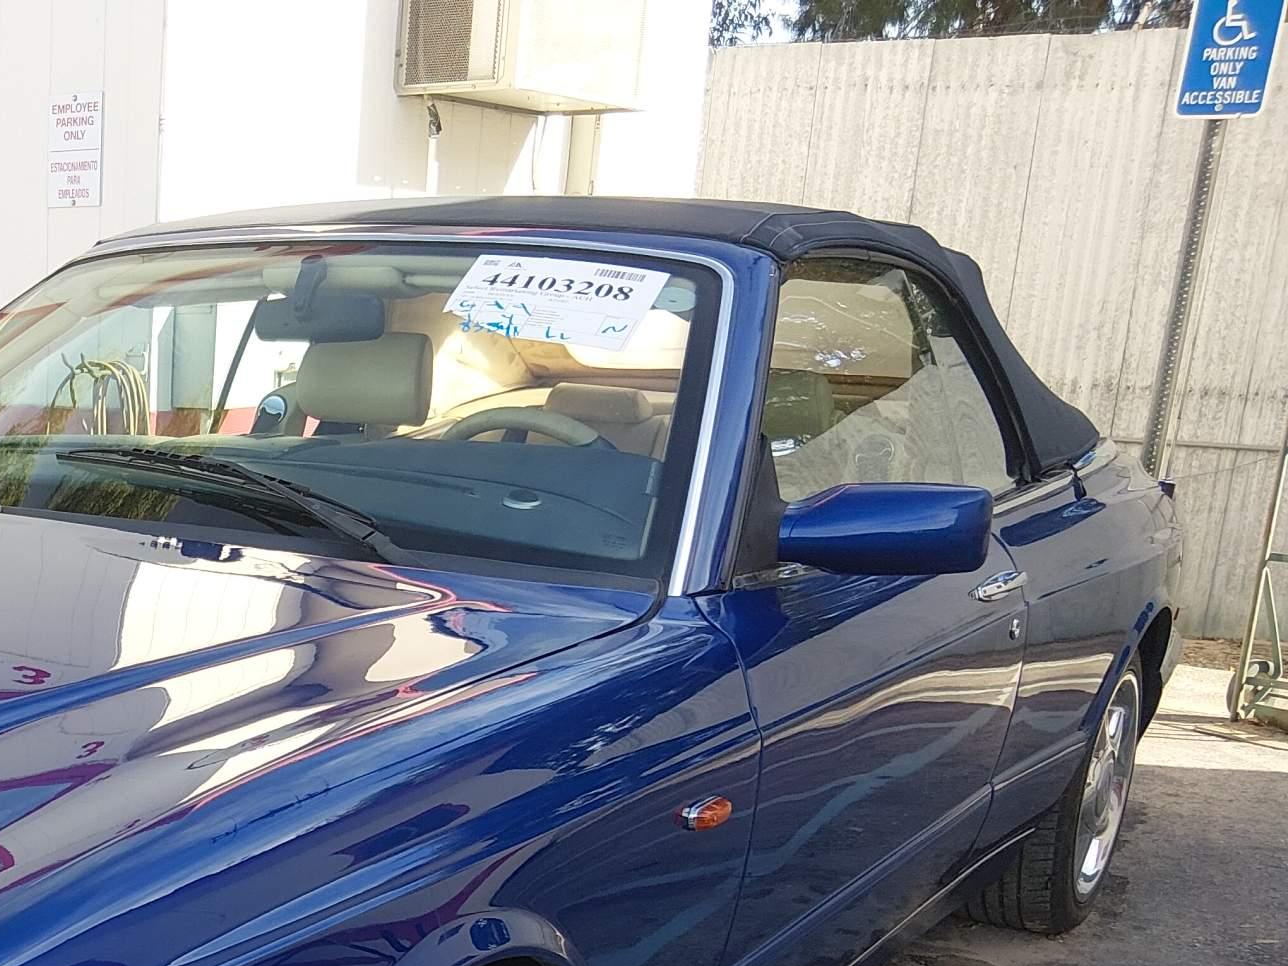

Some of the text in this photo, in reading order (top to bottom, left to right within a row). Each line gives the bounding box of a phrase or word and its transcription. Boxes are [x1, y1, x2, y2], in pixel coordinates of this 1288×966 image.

[1203, 47, 1257, 60] PARKING
[1211, 62, 1244, 75] ONLY
[1213, 77, 1237, 89] VAN
[1181, 89, 1262, 105] ACCESSIBLE
[52, 101, 99, 114] EMPLOYEE
[56, 116, 94, 127] PARKING
[64, 130, 86, 141] ONLY
[67, 175, 80, 185] PARA
[482, 272, 635, 302] 44103208
